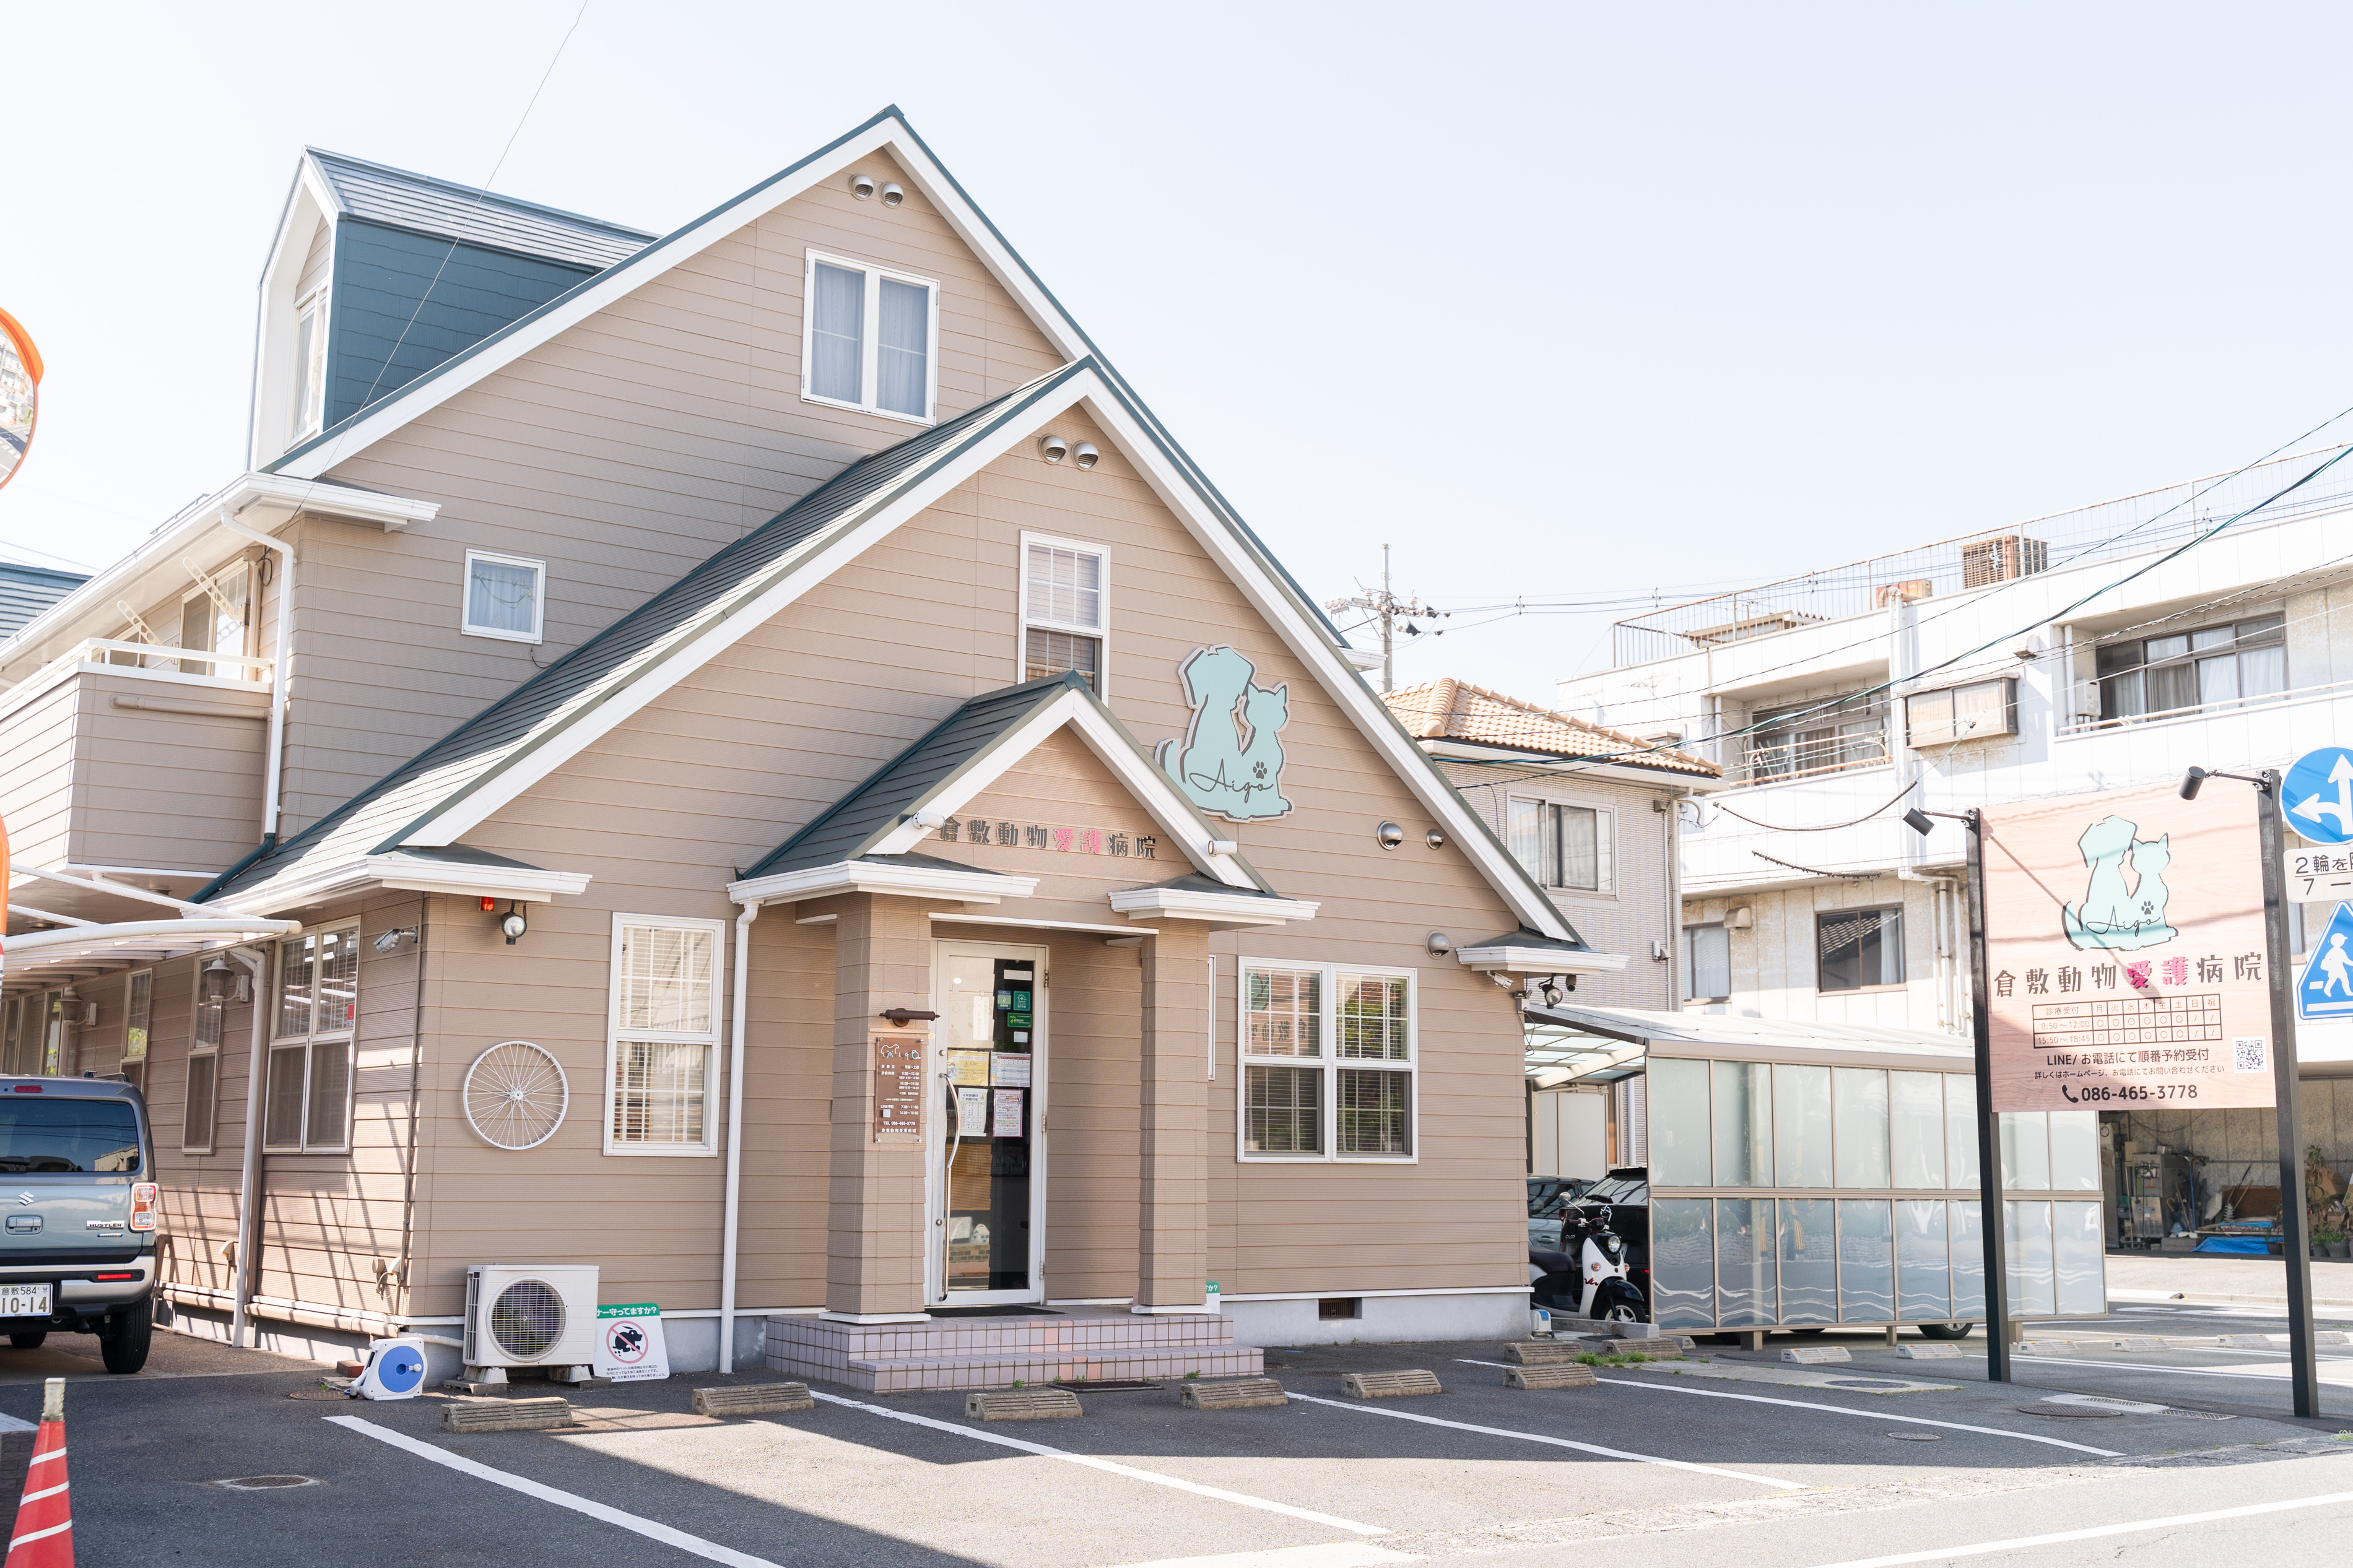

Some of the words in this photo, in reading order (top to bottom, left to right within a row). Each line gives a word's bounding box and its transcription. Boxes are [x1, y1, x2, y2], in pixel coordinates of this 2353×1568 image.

[1189, 758, 1274, 803] Aigo
[941, 816, 1156, 859] 倉敷動物愛護病院
[2295, 852, 2353, 874] 2輪を
[2086, 905, 2160, 937] Aigo
[1994, 951, 2262, 997] 倉敷動物愛護病院
[2046, 1007, 2079, 1016] 診療受付
[2095, 1005, 2103, 1013] 月
[2112, 1004, 2120, 1012] 火
[2126, 1003, 2135, 1011] 水
[2142, 1002, 2151, 1010] 木
[2159, 1001, 2167, 1009] 金
[2207, 998, 2216, 1007] 祝
[2081, 1048, 2209, 1065] お電話にて順番予約受付
[2081, 1085, 2198, 1101] 086-465-3778
[2, 1296, 48, 1314] 10-14
